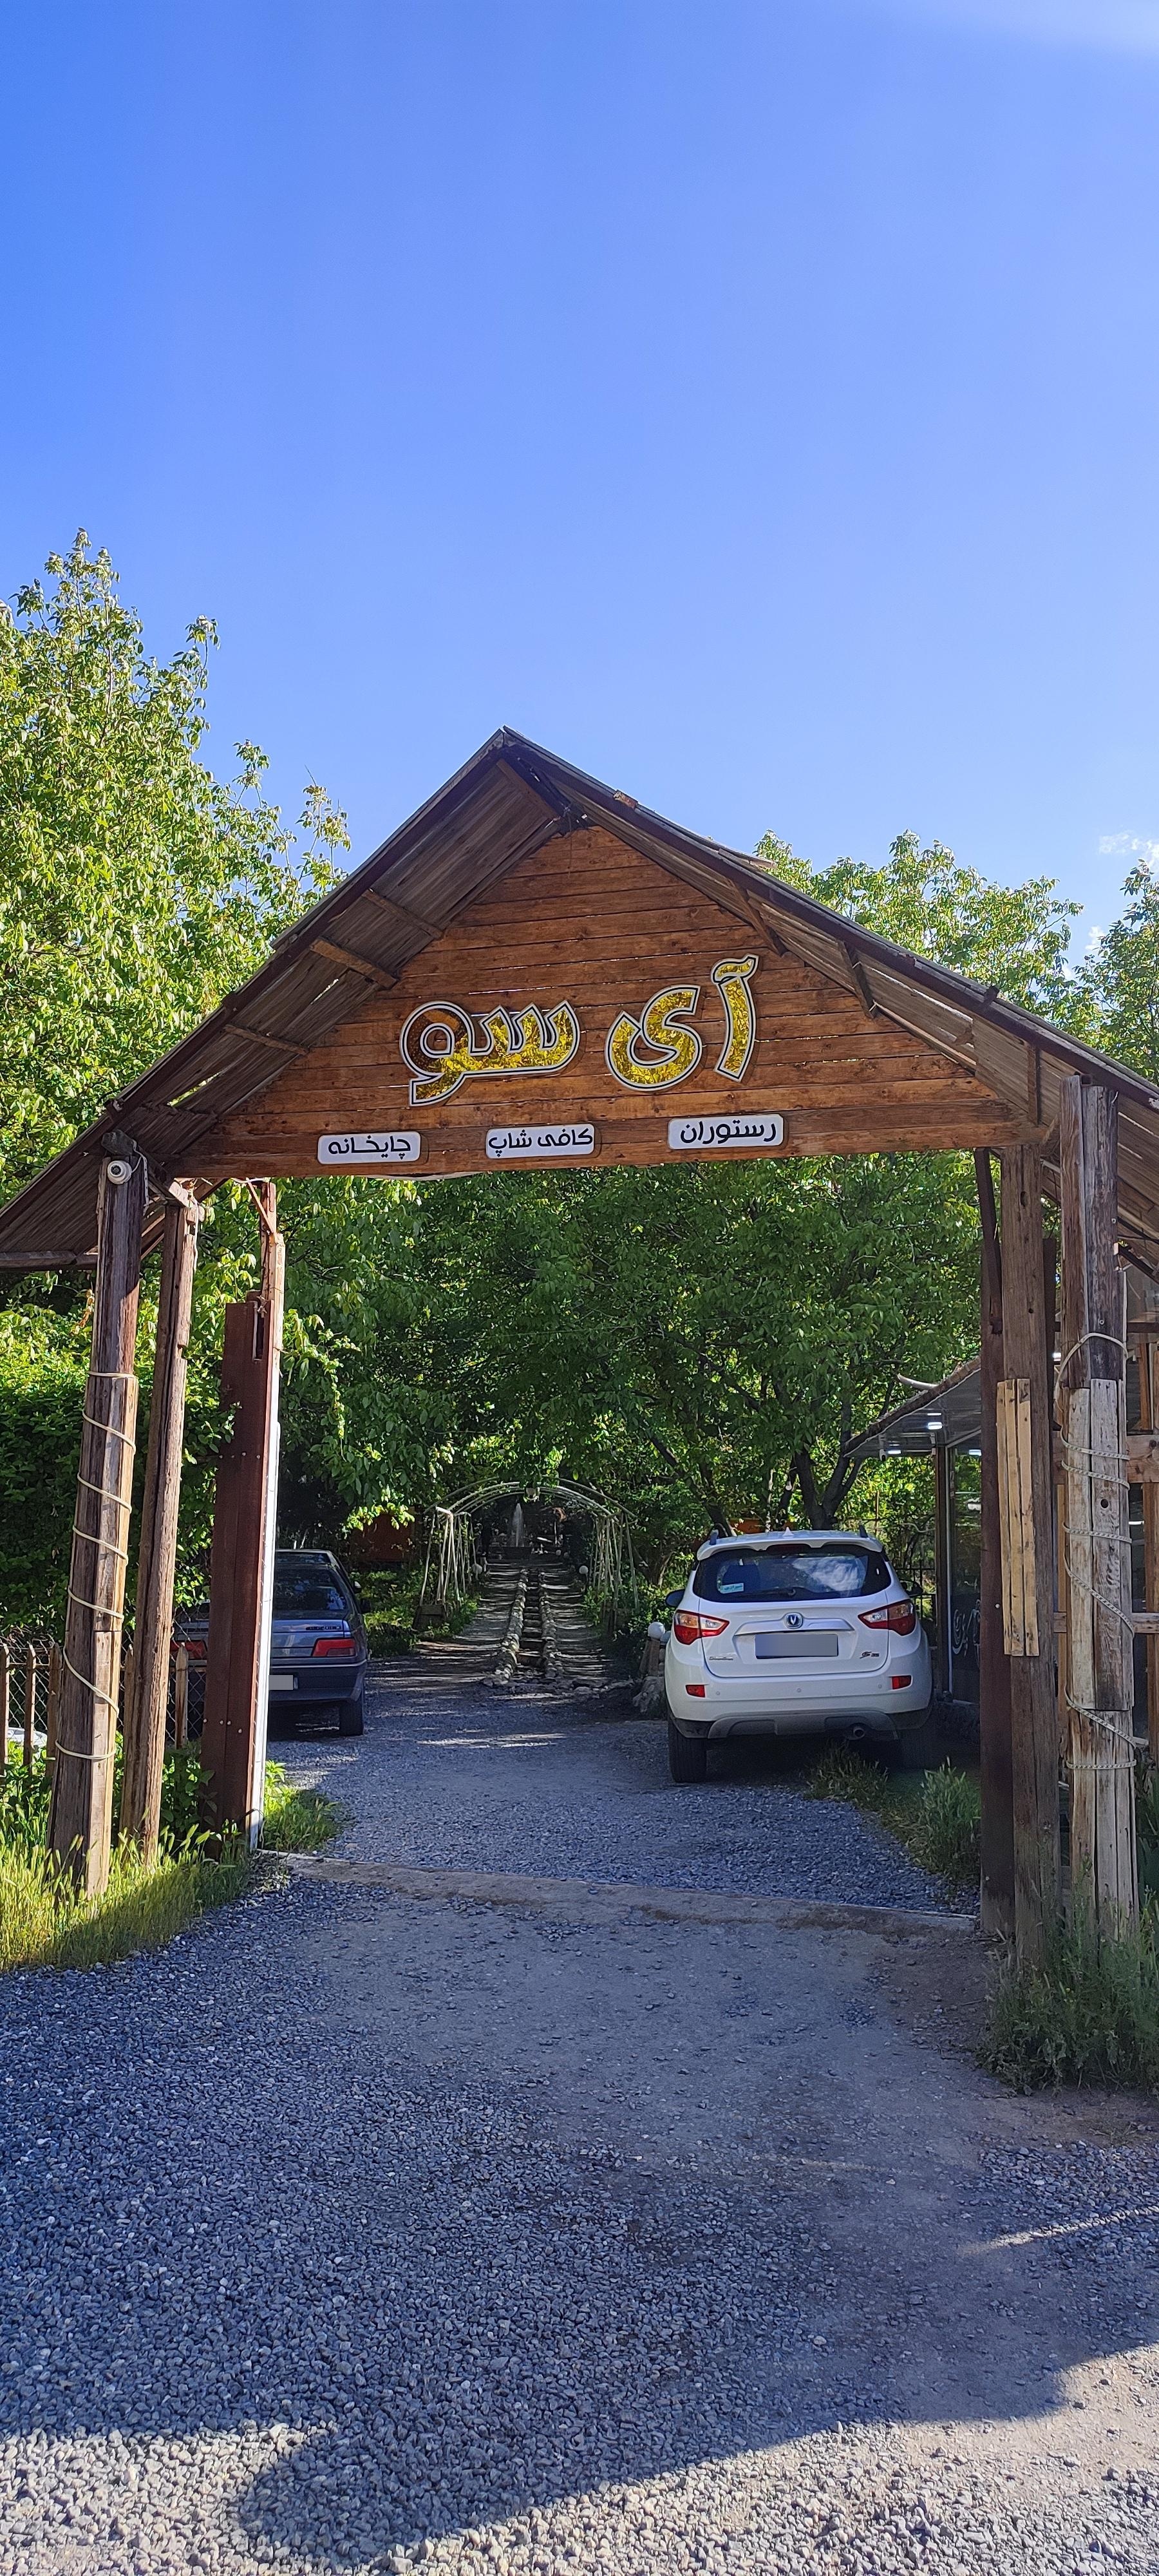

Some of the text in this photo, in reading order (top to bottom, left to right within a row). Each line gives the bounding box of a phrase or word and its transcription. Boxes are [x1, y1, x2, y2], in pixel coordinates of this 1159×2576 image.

[399, 954, 759, 1106] آی سو
[488, 1128, 593, 1157] کافی شاپ
[680, 1119, 777, 1144] رستوران
[328, 1135, 411, 1160] چایخانه
